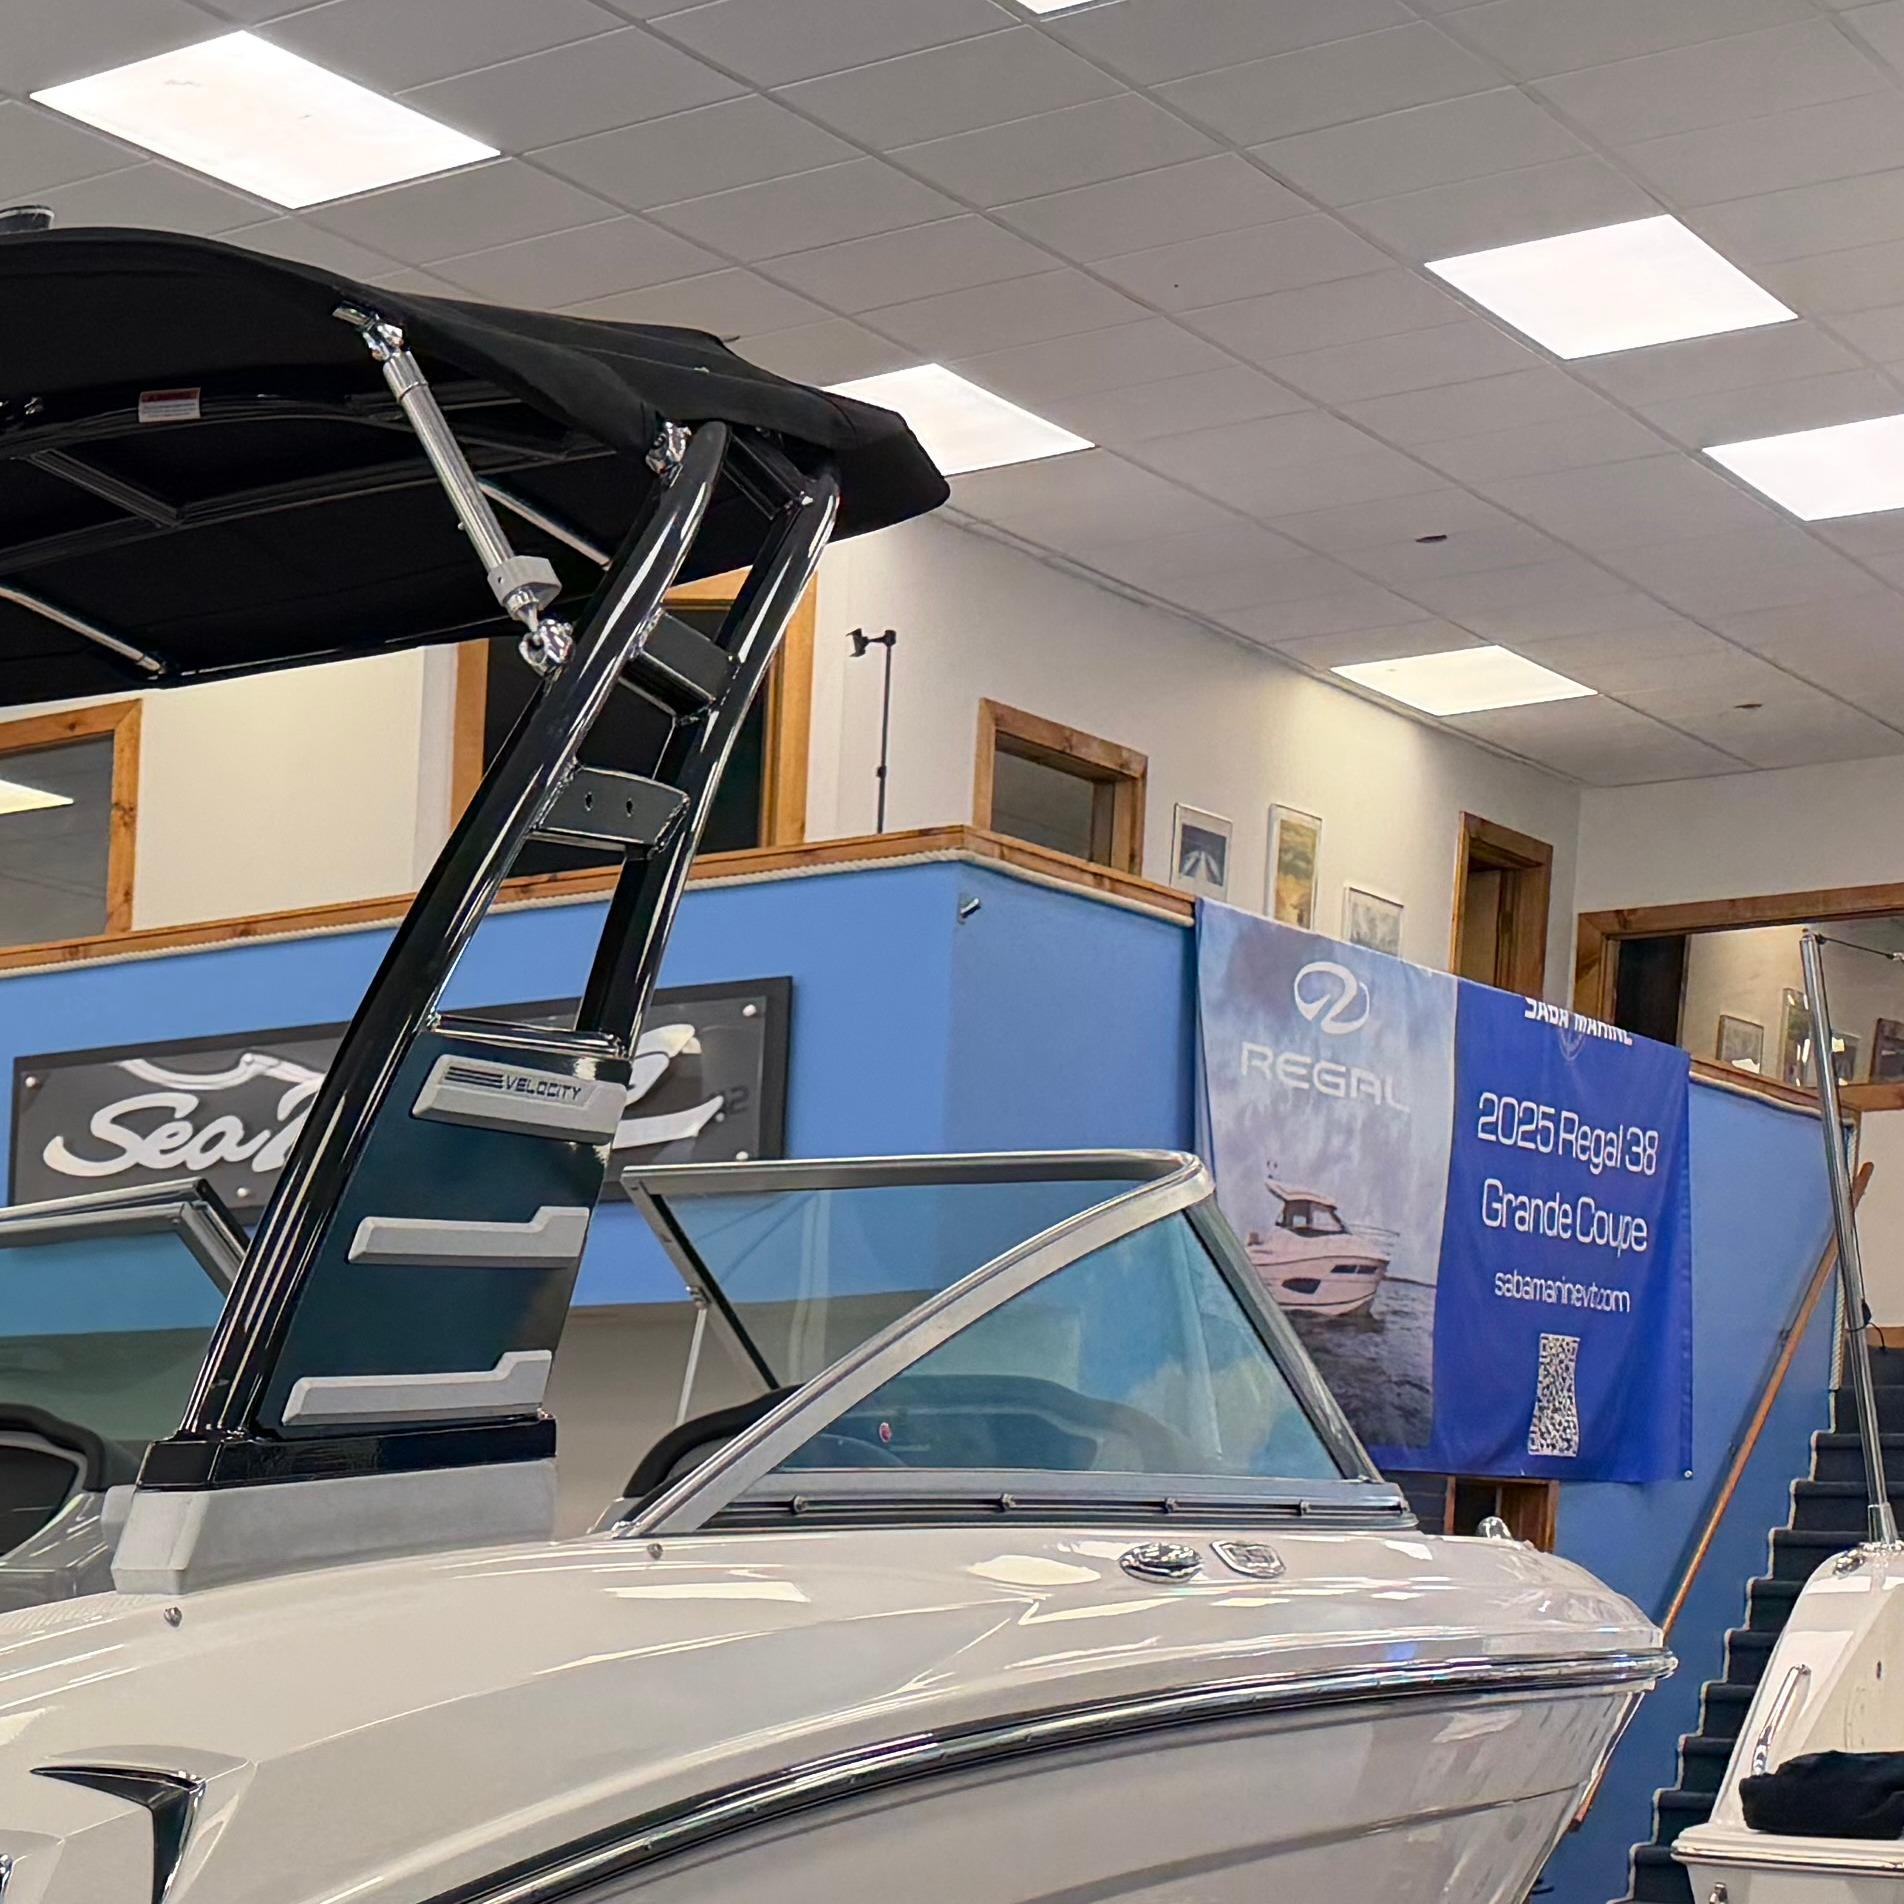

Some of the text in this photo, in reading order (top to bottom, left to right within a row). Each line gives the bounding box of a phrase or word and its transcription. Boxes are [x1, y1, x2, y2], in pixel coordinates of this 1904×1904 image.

[503, 1076, 583, 1102] VELOCITY
[1240, 1041, 1411, 1114] REGAL
[1477, 1091, 1659, 1177] 2025 Regal 38
[1482, 1178, 1649, 1258] Grande Coupe
[1494, 1269, 1631, 1315] sabamarinevt.com
